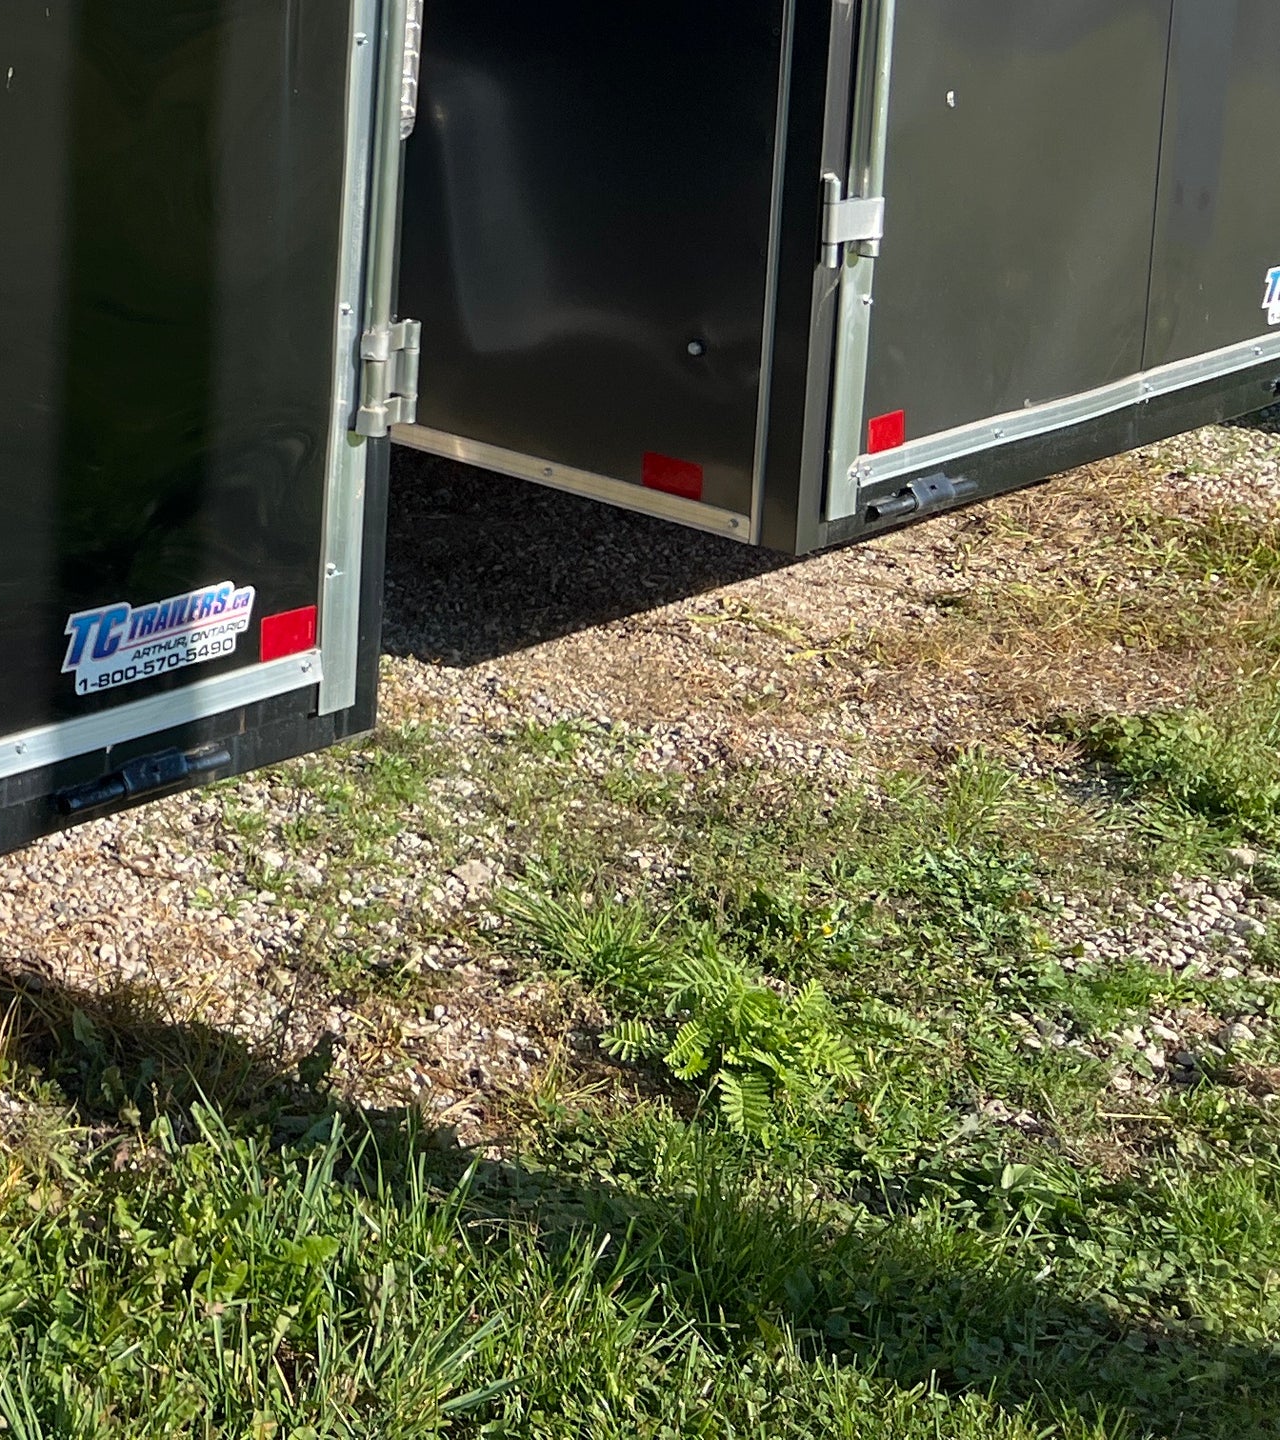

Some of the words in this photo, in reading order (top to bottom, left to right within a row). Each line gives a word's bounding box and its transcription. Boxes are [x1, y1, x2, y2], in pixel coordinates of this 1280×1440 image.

[68, 606, 127, 666] TC
[131, 635, 189, 661] ARTHUR,
[190, 618, 247, 644] ONTARIO
[79, 638, 234, 692] 1-800-570-5490
